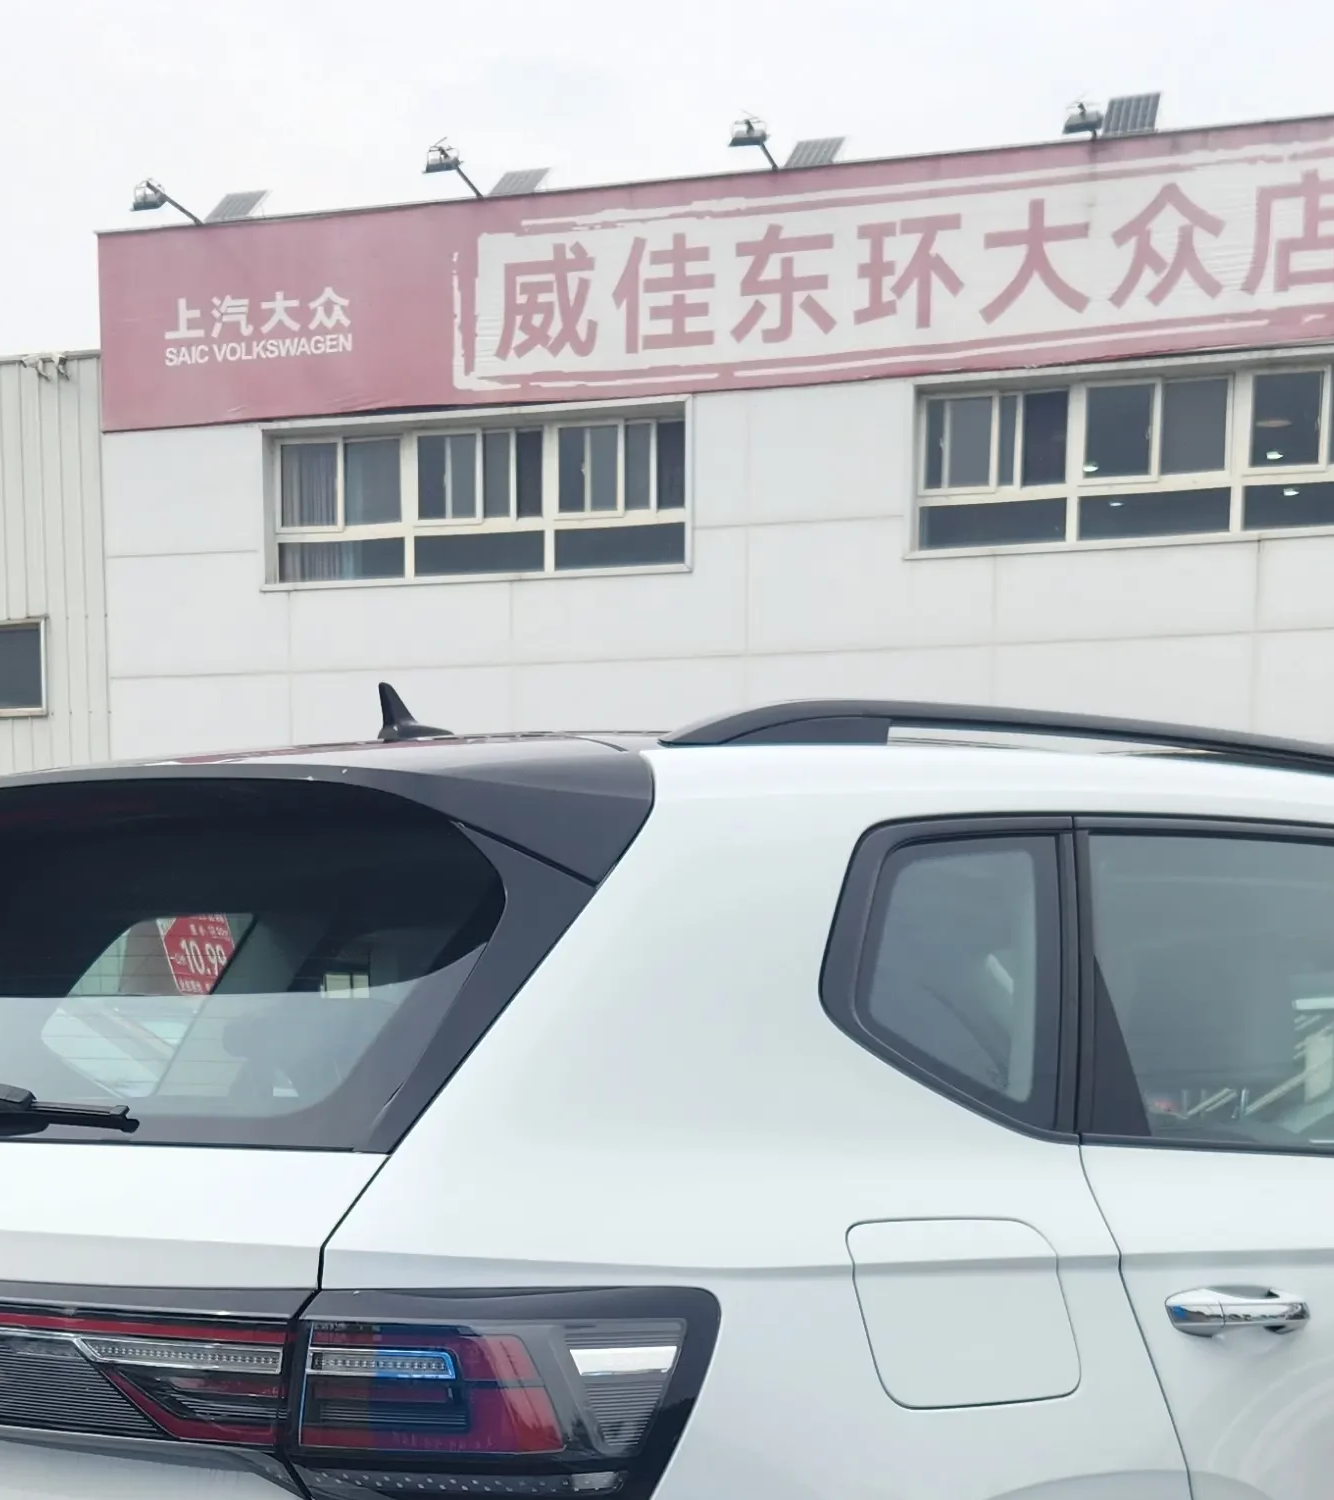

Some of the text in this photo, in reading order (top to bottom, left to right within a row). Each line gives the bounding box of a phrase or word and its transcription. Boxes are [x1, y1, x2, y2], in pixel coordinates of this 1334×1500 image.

[165, 286, 351, 340] 上汽大众
[165, 333, 353, 366] SAIC VOLKSWAGEN
